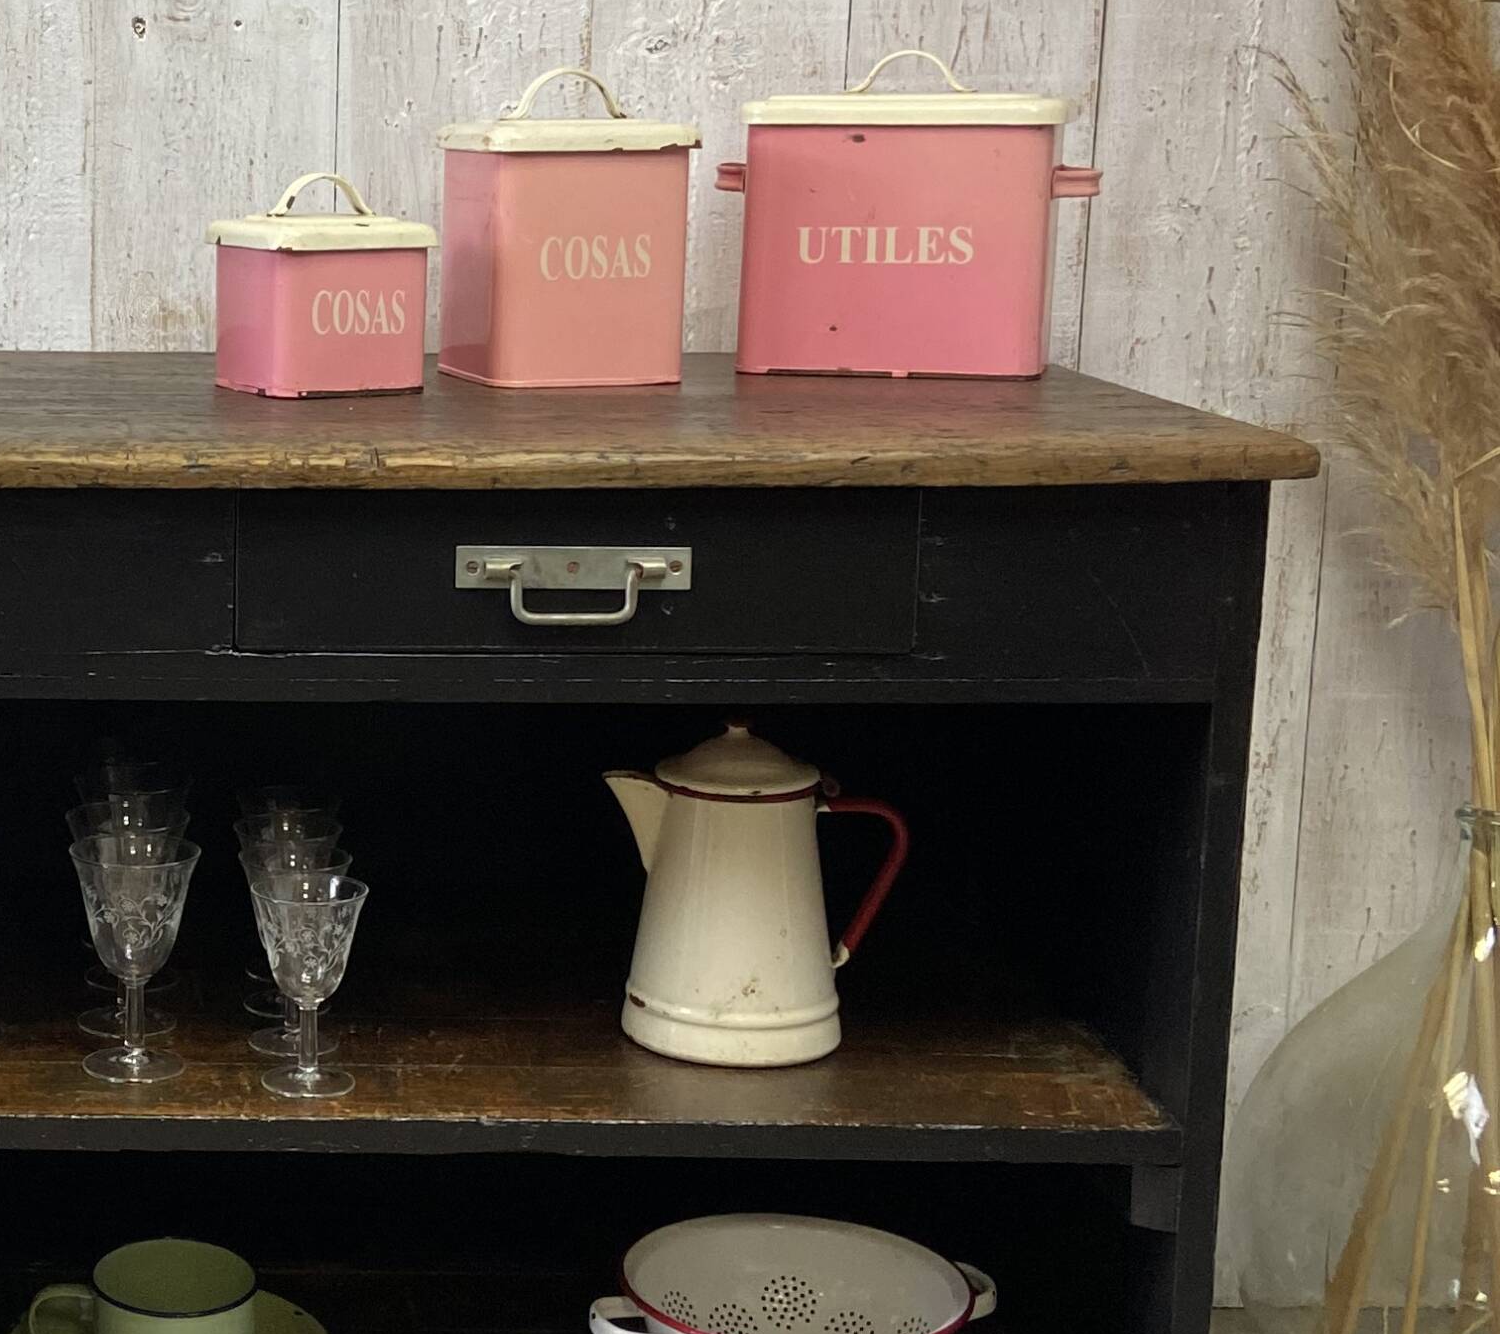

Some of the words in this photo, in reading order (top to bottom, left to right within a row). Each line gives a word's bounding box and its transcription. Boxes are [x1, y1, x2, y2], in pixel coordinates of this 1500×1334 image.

[537, 232, 653, 283] COSAS
[797, 223, 975, 266] UTILES
[309, 286, 407, 337] COSAS
